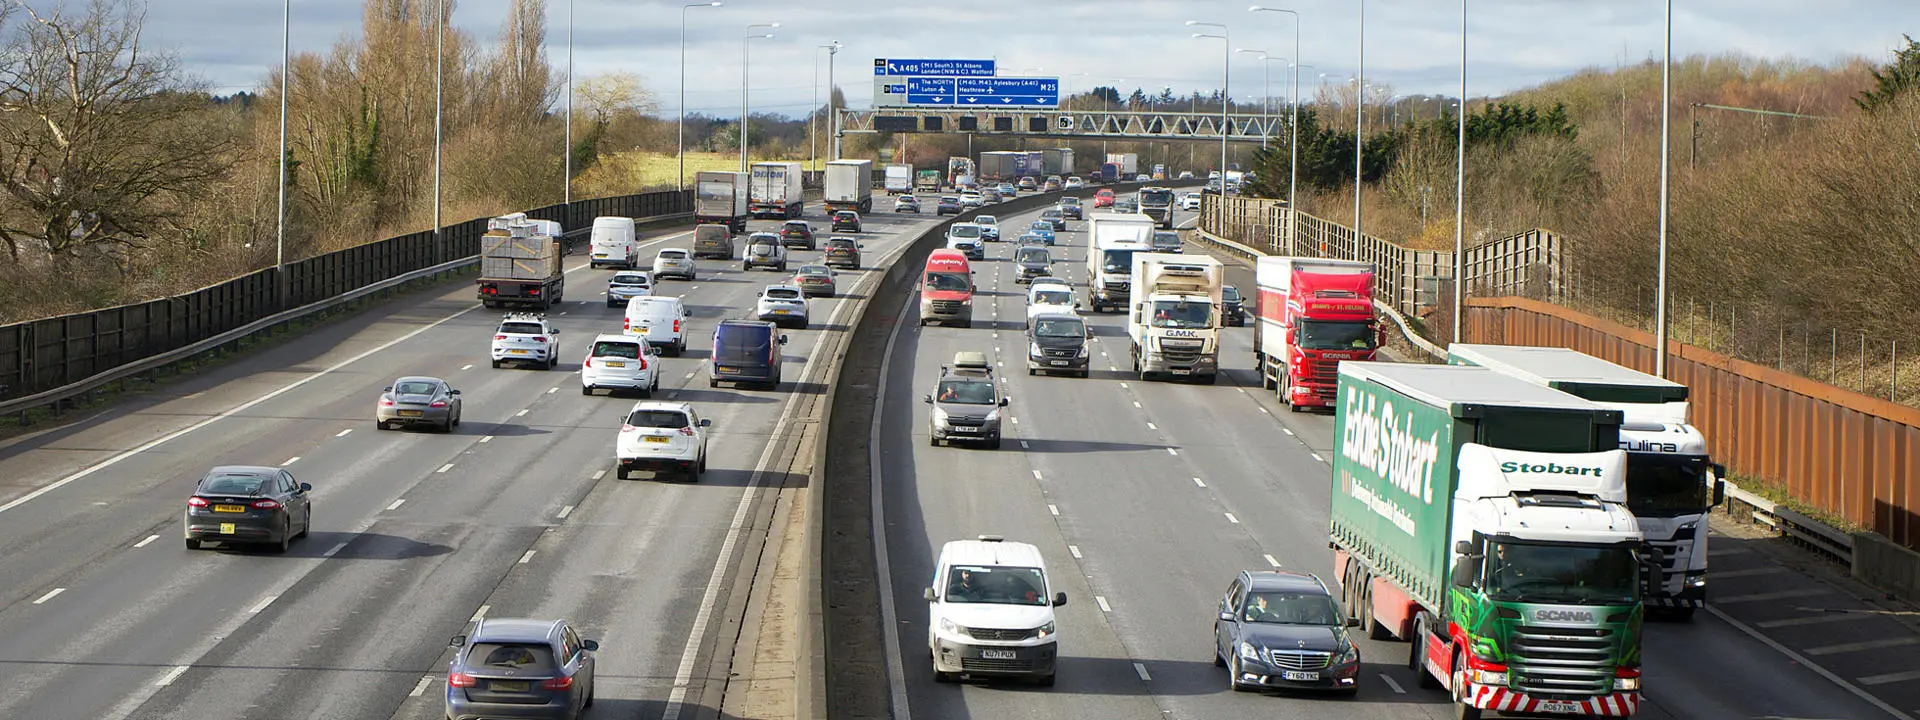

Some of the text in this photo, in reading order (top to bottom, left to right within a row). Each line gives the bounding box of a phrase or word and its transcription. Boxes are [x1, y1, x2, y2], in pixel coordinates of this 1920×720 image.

[1343, 386, 1438, 505] Eddie Stobart
[1501, 462, 1602, 477] Stobart
[1536, 610, 1594, 622] SCANIA
